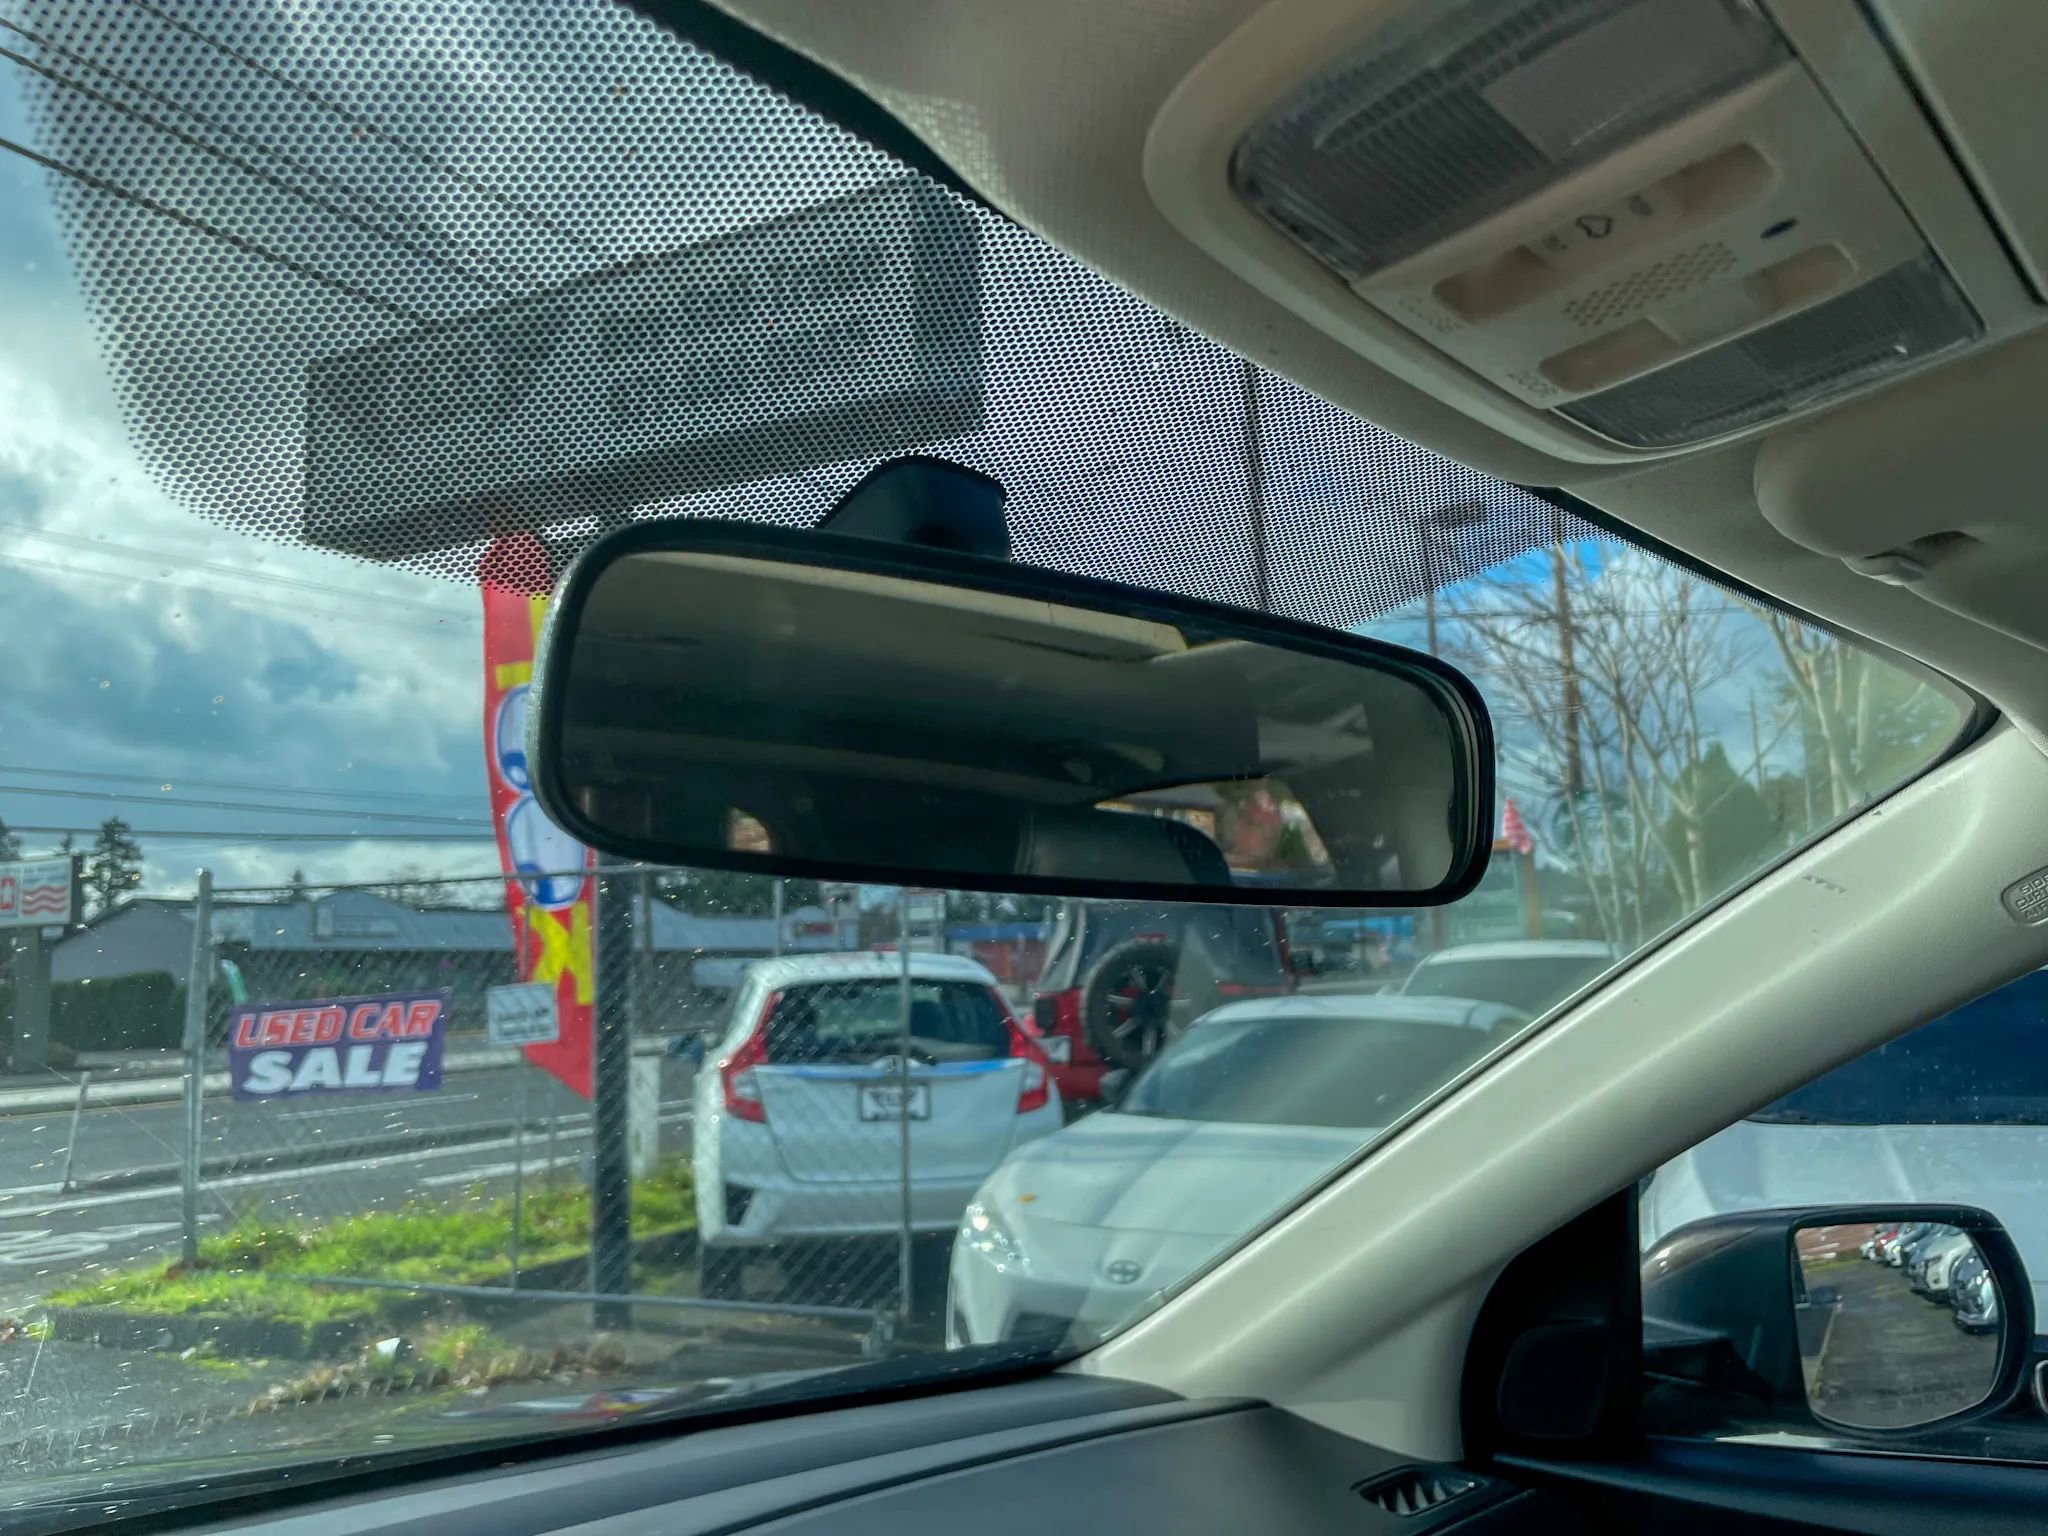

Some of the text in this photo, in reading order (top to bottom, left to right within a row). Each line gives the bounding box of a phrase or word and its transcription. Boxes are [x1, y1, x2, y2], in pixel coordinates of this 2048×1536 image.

[235, 1000, 442, 1048] USED CAR
[242, 1041, 428, 1094] SALE
